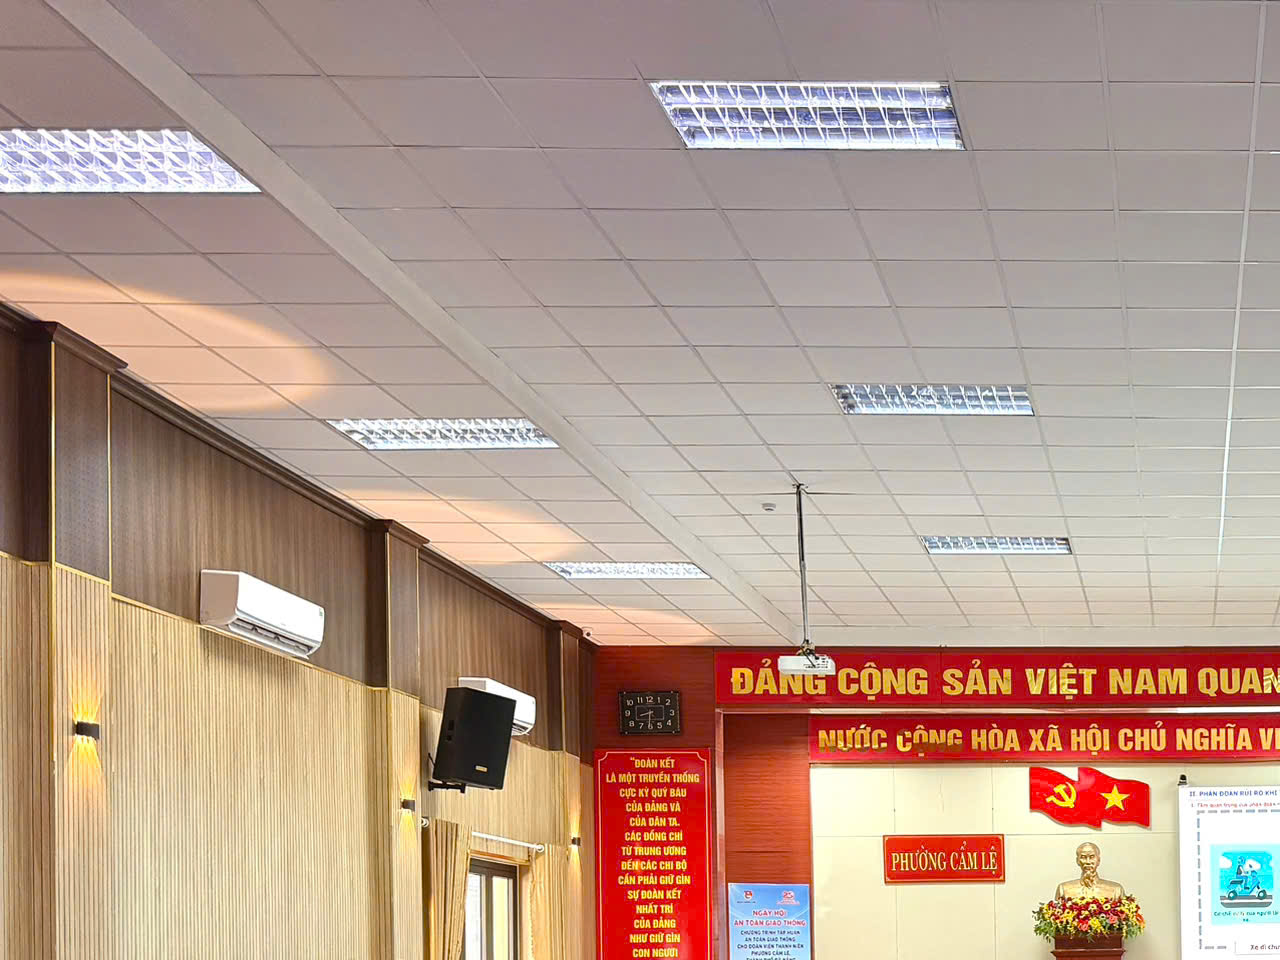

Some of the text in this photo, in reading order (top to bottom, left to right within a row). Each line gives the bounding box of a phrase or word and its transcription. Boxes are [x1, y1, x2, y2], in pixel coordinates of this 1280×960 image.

[731, 659, 826, 695] ĐẢNG
[838, 662, 928, 700] CỘNG
[943, 657, 1011, 695] SẢN
[1024, 663, 1097, 700] VIỆT
[1109, 667, 1188, 695] NAM
[818, 722, 888, 752] NƯỚC
[896, 724, 963, 757] CỘNG
[971, 723, 1021, 752] HÒA
[1029, 723, 1063, 752] XÃ
[1071, 723, 1110, 756] HỘI
[1118, 720, 1166, 751] CHỦ
[1175, 723, 1251, 751] NGHĨA
[891, 840, 997, 875] PHƯỜNG CẨM LỆ
